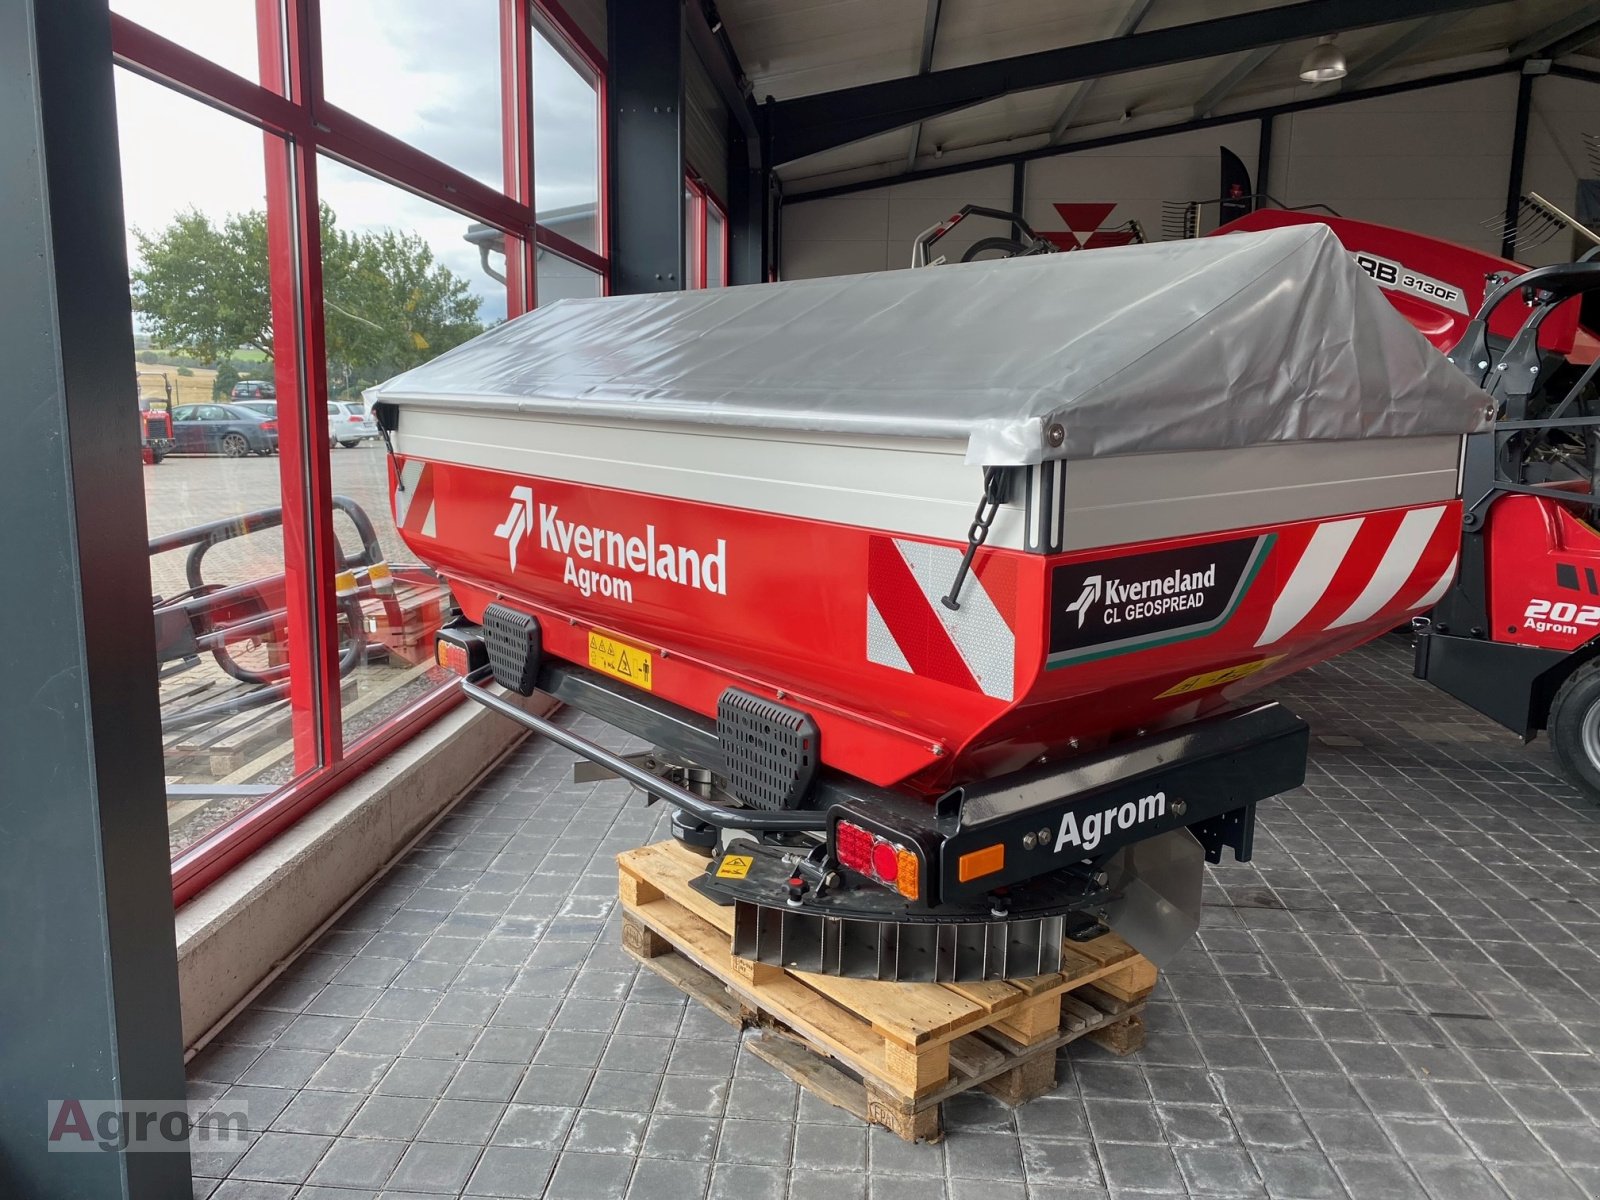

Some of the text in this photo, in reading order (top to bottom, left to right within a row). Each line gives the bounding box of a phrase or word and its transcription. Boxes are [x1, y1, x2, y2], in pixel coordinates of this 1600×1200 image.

[1403, 275, 1457, 300] 3130F
[539, 503, 727, 595] Kverneland
[563, 556, 633, 603] Agrom
[1104, 563, 1216, 605] Kverneland
[1103, 592, 1204, 625] CL GEOSPREAD
[1523, 618, 1578, 635] Agrom
[1053, 790, 1166, 853] Agrom
